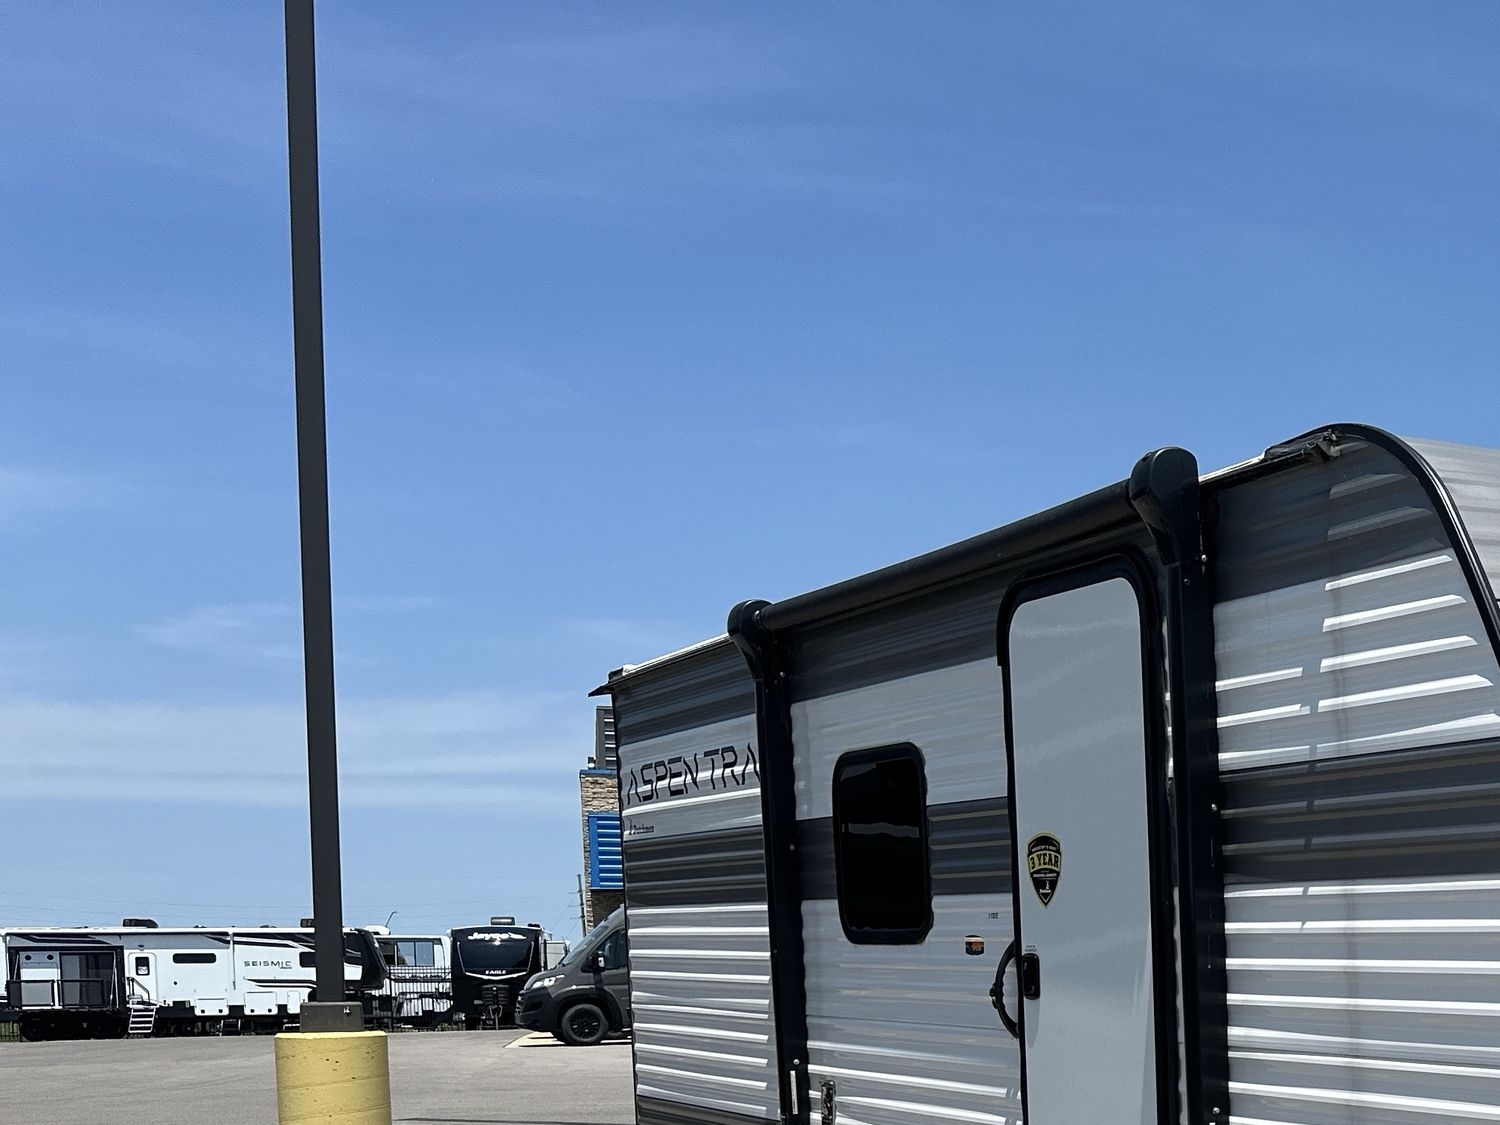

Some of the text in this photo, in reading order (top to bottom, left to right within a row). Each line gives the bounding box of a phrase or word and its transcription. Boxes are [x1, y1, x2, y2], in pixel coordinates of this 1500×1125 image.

[627, 743, 760, 805] ASPEN TRA
[1030, 853, 1059, 869] 3 YEAR
